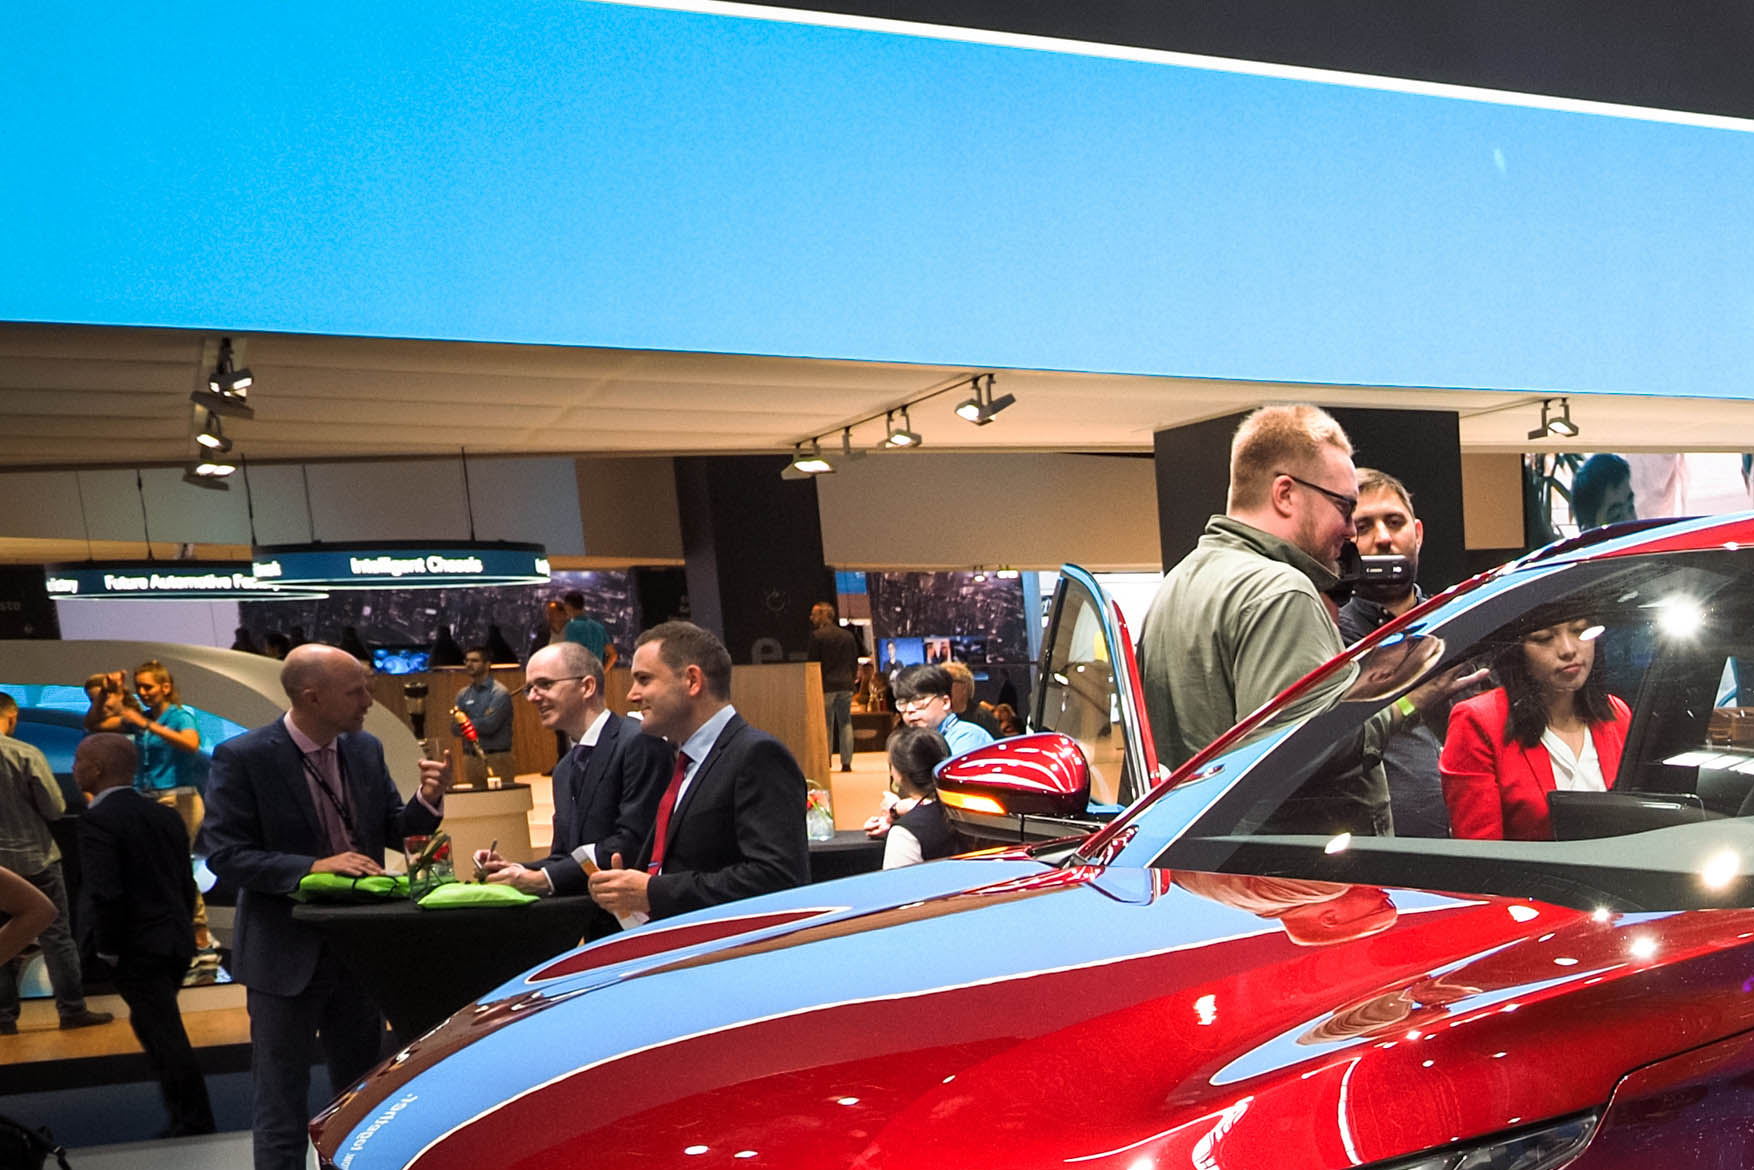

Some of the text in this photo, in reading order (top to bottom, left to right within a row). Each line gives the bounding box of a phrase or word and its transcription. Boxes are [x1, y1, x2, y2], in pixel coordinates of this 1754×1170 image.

[350, 555, 483, 577] Intelligent Chassis
[104, 574, 149, 590] Future
[150, 574, 233, 590] Automotive
